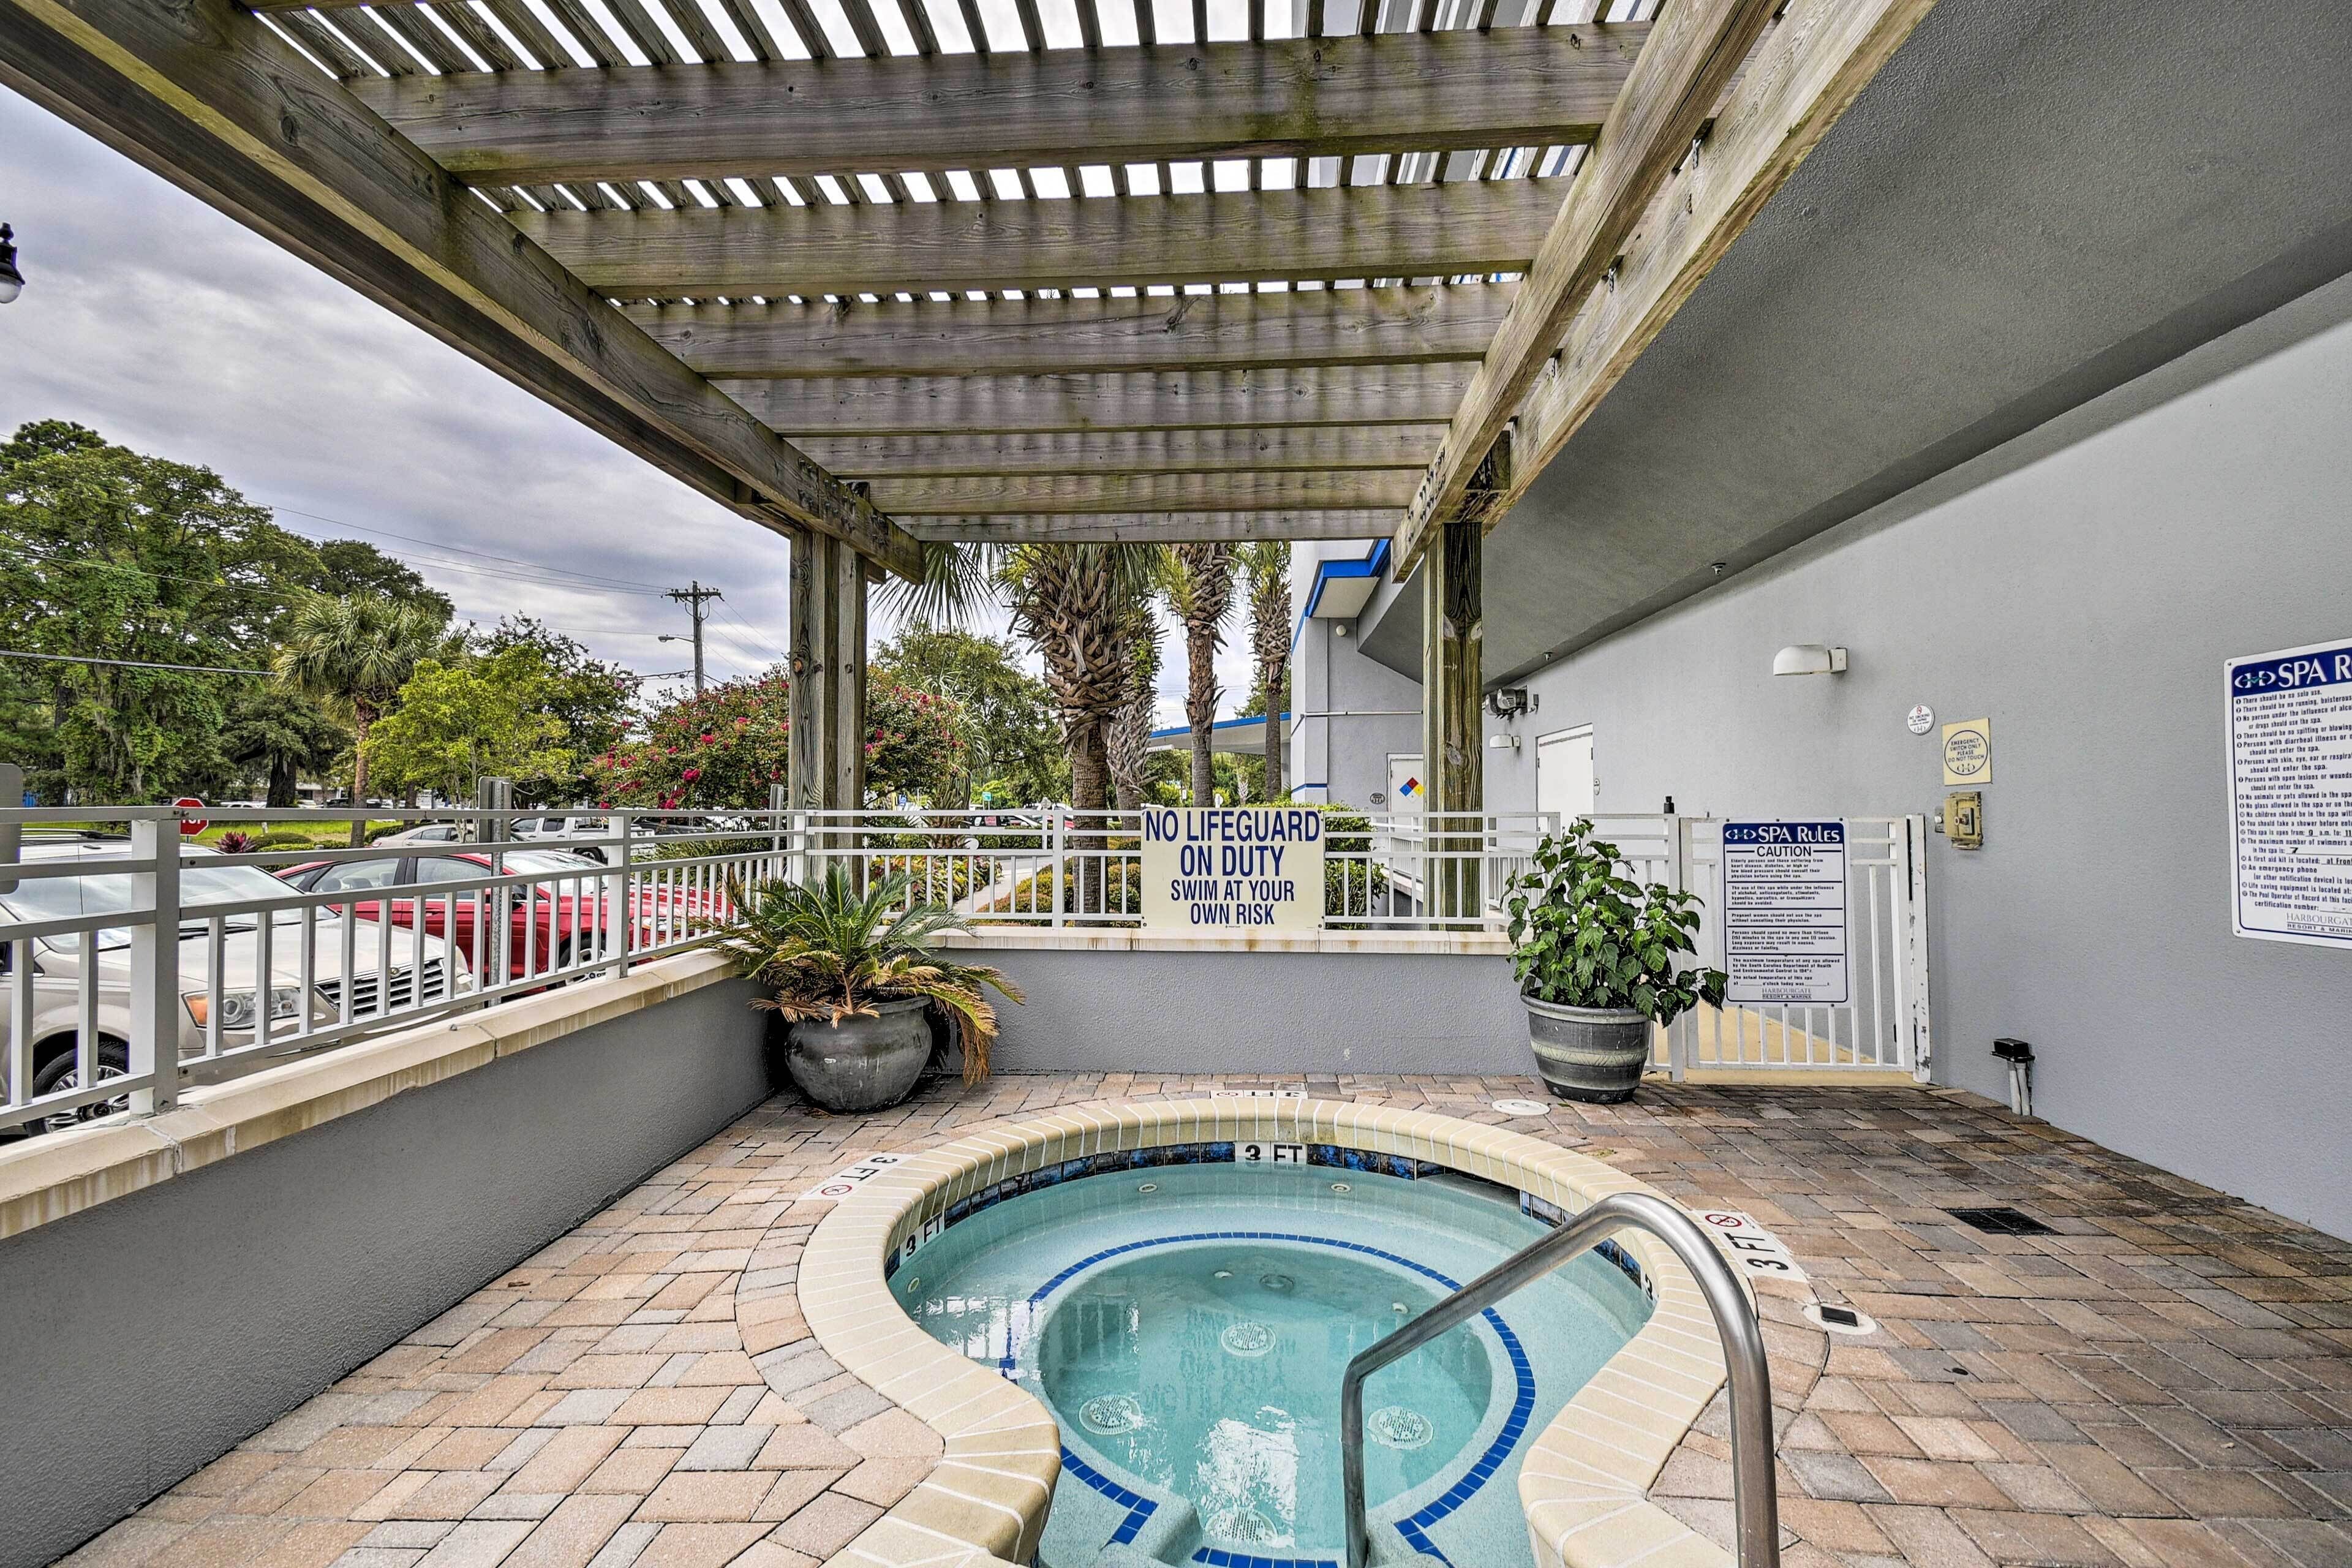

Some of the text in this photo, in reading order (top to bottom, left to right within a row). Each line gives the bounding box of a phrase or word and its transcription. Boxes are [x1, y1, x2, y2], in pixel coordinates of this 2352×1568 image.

[2278, 654, 2352, 688] SPA R
[1145, 810, 1320, 842] NO LIFEGUARD
[1758, 826, 1793, 842] SPA
[1180, 845, 1285, 876] ON DUTY
[1757, 846, 1811, 857] CAUTION
[1170, 880, 1295, 902] SWIM AT YOUR
[1190, 903, 1275, 925] OWN RISK
[1245, 1144, 1303, 1163] 3 FT
[840, 1167, 880, 1182] FT
[906, 1215, 942, 1257] 3 FT
[1724, 1232, 1789, 1271] 3 FT
[1645, 1273, 1653, 1300] 3
